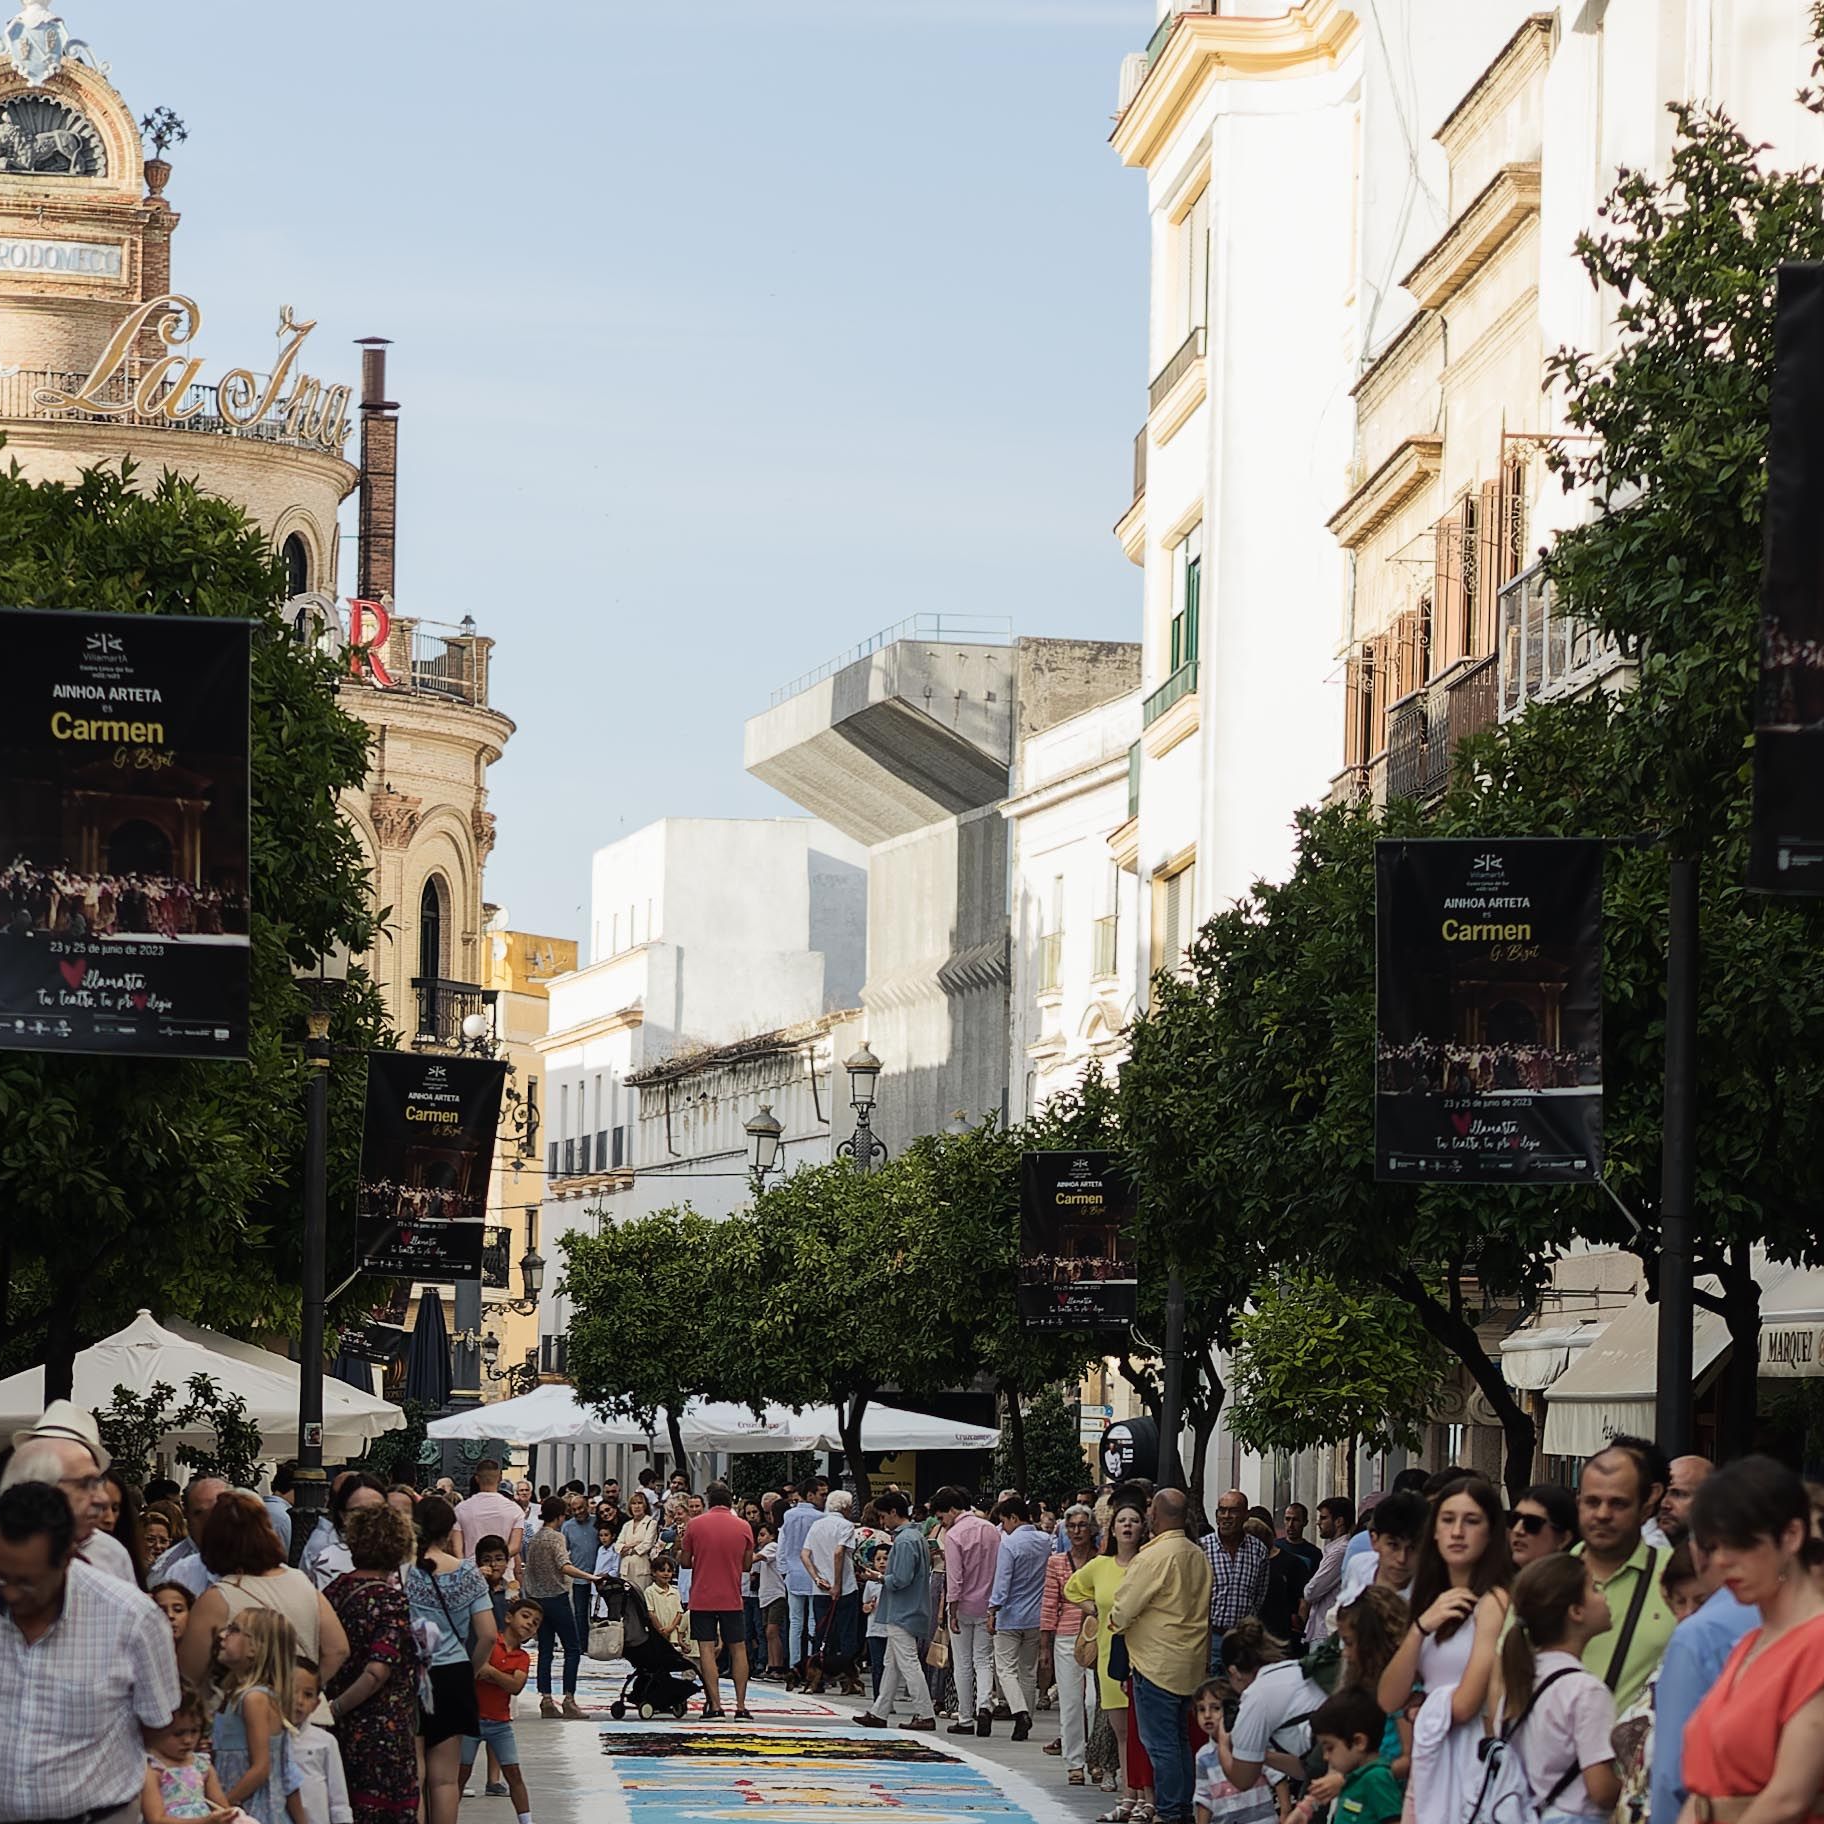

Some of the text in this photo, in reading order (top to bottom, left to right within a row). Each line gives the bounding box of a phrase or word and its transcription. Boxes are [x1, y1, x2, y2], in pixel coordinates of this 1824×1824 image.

[32, 293, 206, 421] La
[52, 683, 162, 703] AINHOA ARTETA
[50, 710, 165, 744] Carmen
[1444, 897, 1531, 909] AINHOA ARTETA
[1441, 918, 1532, 942] Carmen
[49, 941, 165, 957] 23 y 25 de junio de 2023
[405, 1105, 459, 1123] Carmen
[1056, 1192, 1104, 1206] Carmen
[1767, 1331, 1813, 1370] MARQUEZ
